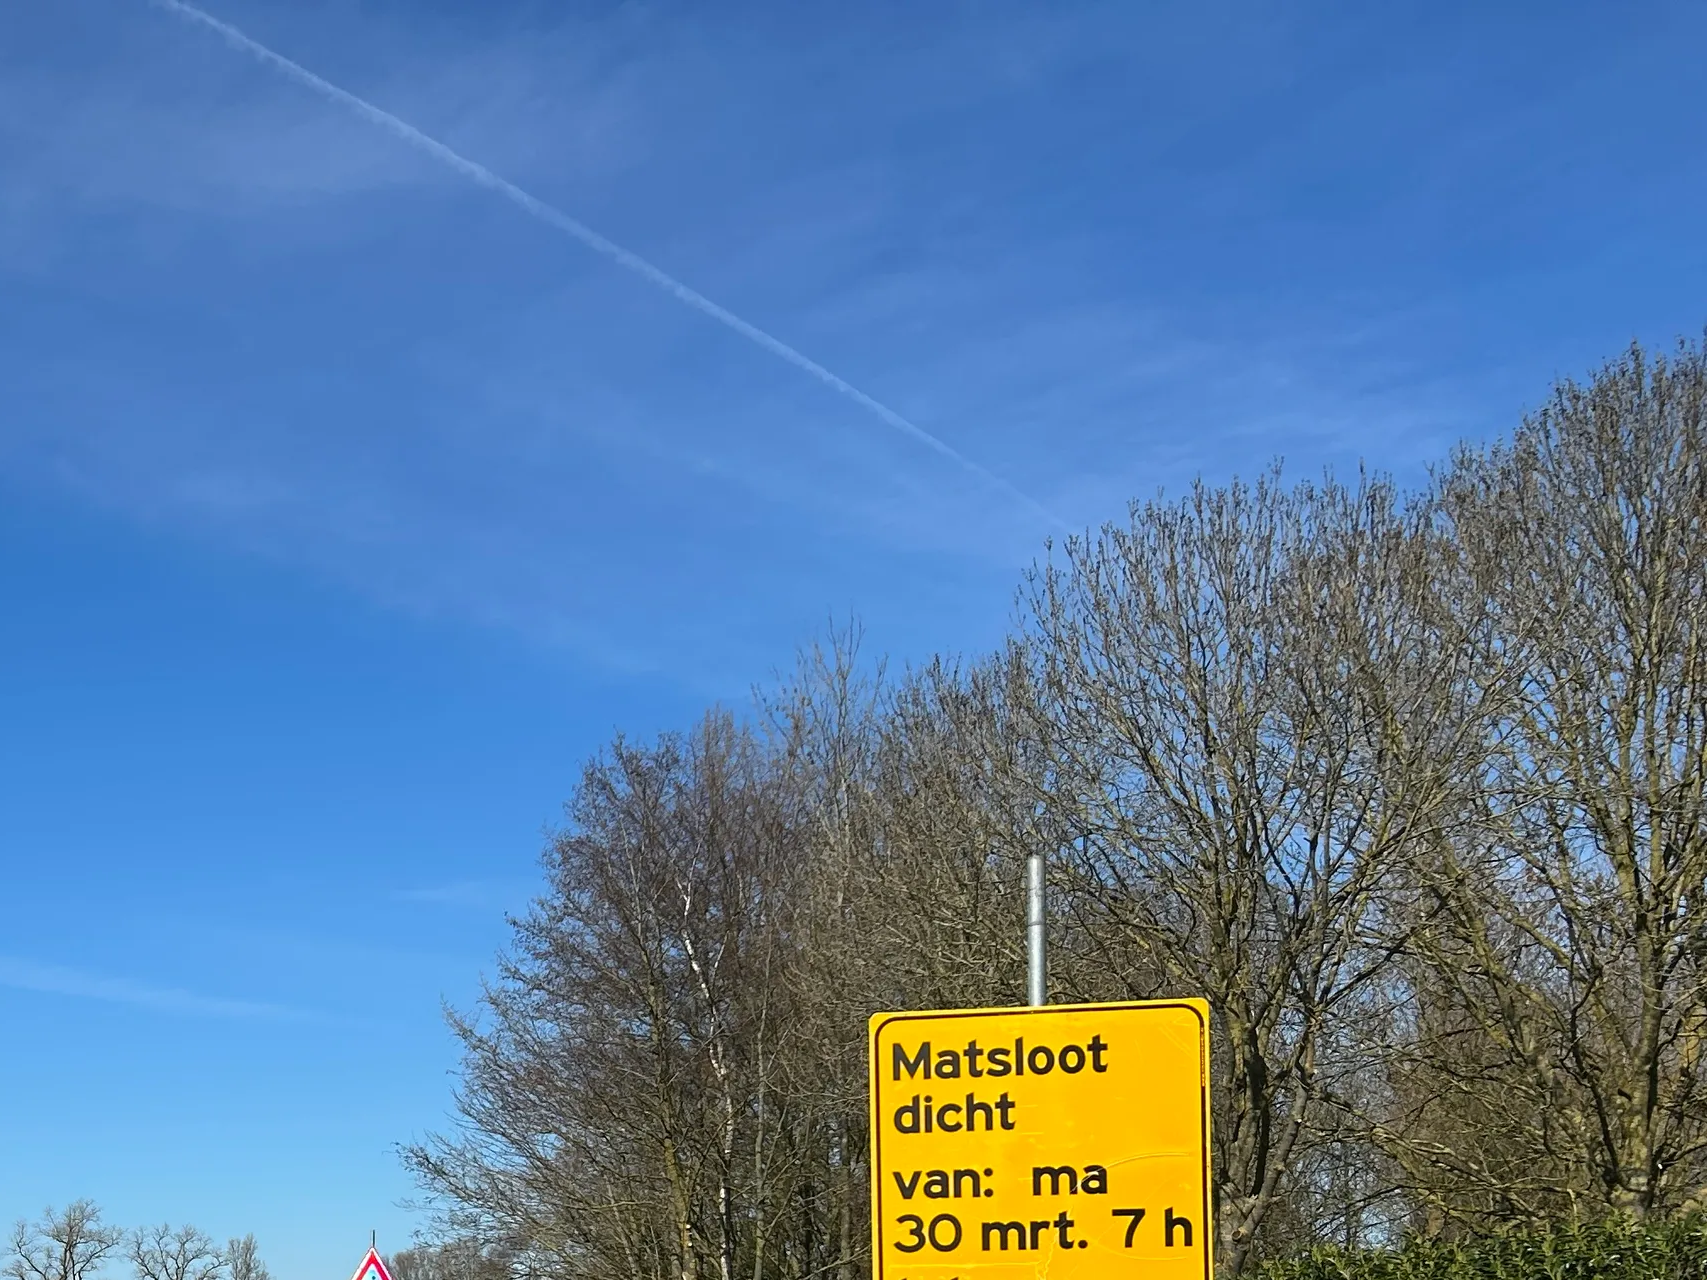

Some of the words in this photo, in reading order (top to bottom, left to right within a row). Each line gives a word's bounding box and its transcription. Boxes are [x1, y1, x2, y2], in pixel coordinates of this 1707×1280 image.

[893, 1035, 1108, 1081] Matsloot
[894, 1093, 1016, 1134] dicht
[893, 1167, 994, 1199] van:
[1032, 1165, 1108, 1196] ma
[894, 1214, 963, 1253] 30
[982, 1212, 1088, 1251] mrt.
[1111, 1209, 1146, 1248] 7
[1164, 1208, 1193, 1247] h
